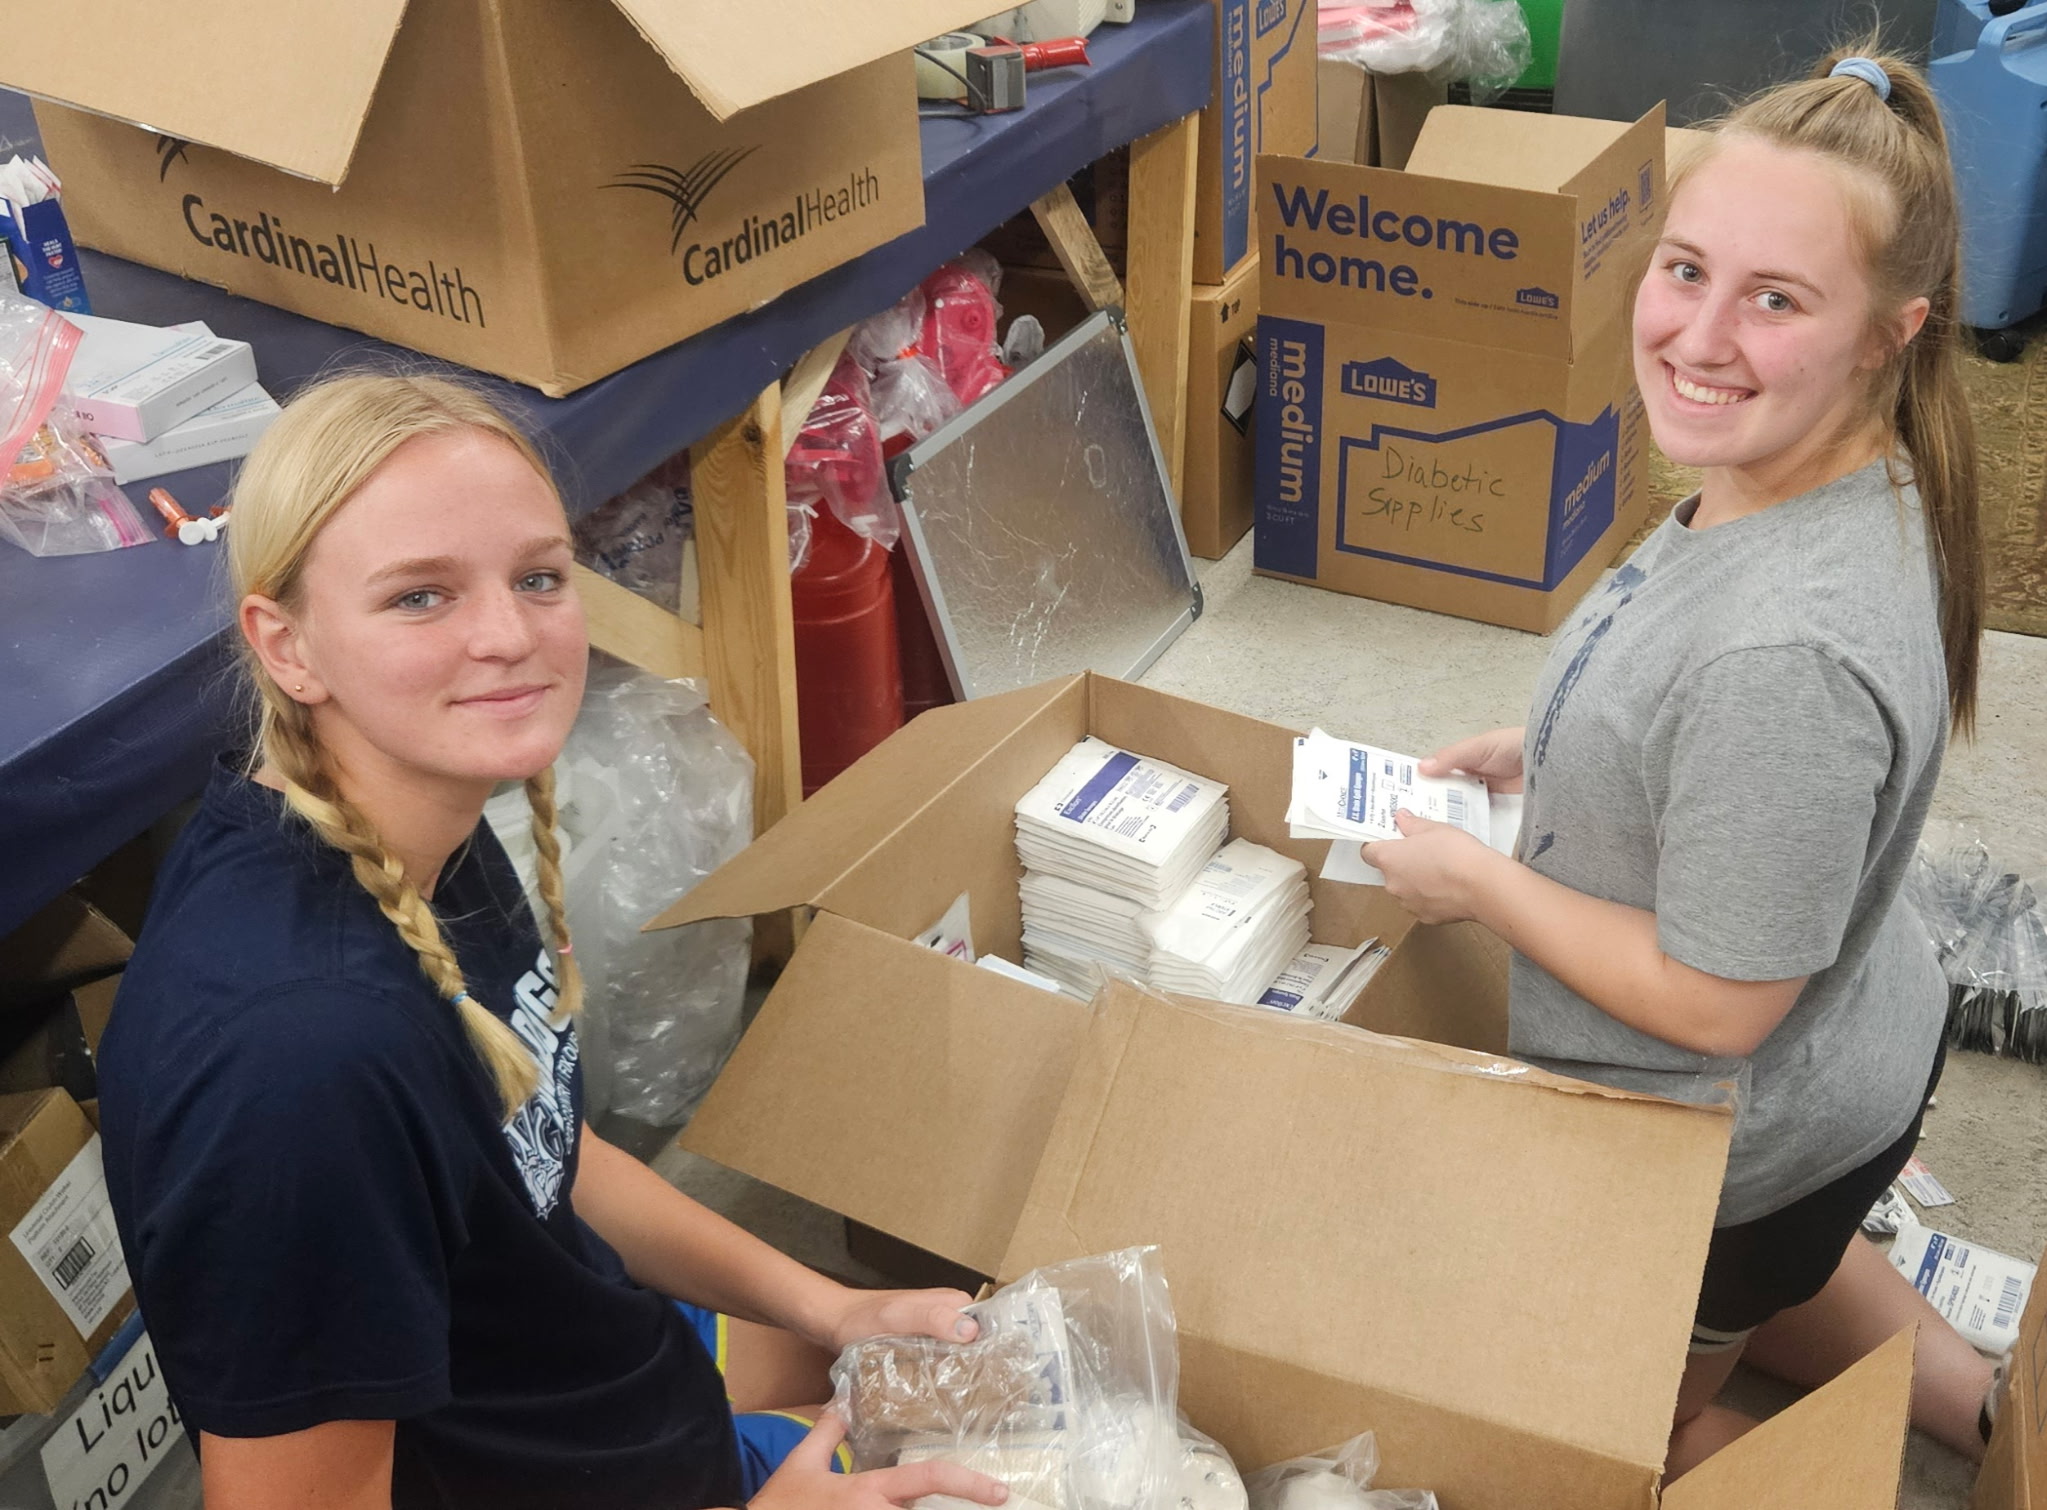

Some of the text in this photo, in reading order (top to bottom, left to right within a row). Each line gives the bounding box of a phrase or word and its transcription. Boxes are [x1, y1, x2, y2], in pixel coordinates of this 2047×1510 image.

[1233, 4, 1248, 189] medium
[1271, 182, 1520, 260] Welcome
[1581, 214, 1597, 245] Let
[1597, 207, 1608, 229] us
[1609, 187, 1631, 219] help.
[1275, 234, 1434, 300] home.
[1519, 291, 1556, 307] LOWE'S
[1268, 337, 1279, 397] mediana
[1351, 368, 1427, 402] LOWE'S
[1279, 340, 1314, 503] medium
[1382, 445, 1505, 497] Diabetic
[1563, 449, 1610, 516] medium
